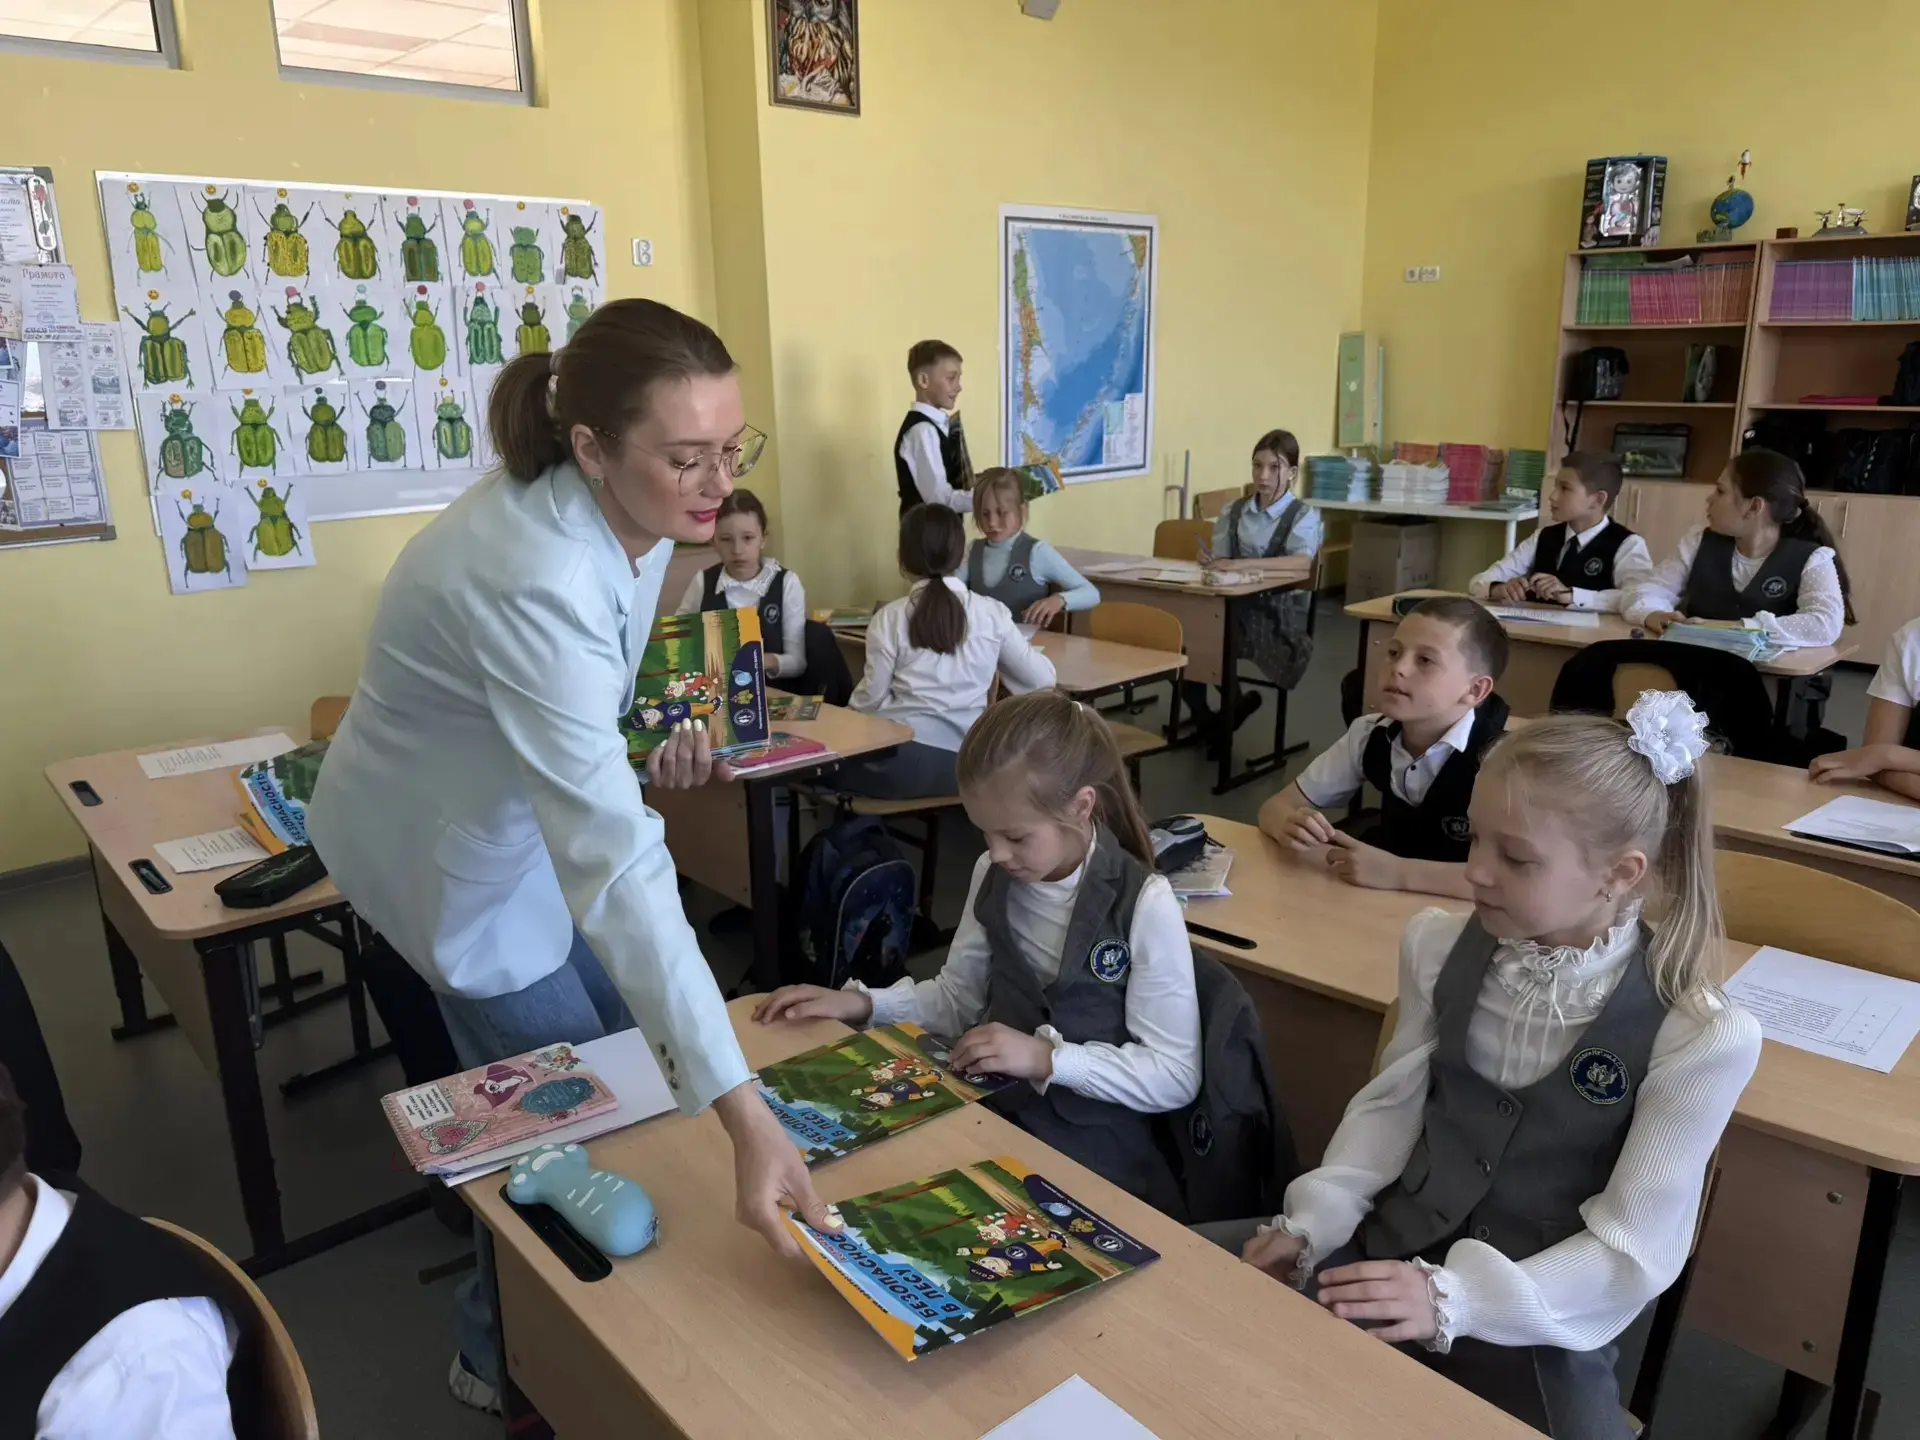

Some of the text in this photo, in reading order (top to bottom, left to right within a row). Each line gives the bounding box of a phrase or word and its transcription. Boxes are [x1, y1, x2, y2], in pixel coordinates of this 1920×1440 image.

[22, 268, 66, 281] Грамота
[256, 773, 305, 841] БЕЗОПАСНОСТЬ
[797, 1110, 835, 1130] ЛЕСУ
[828, 1234, 940, 1319] БЕЗОПАСНОС
[893, 1268, 962, 1313] В ЛЕСУ
